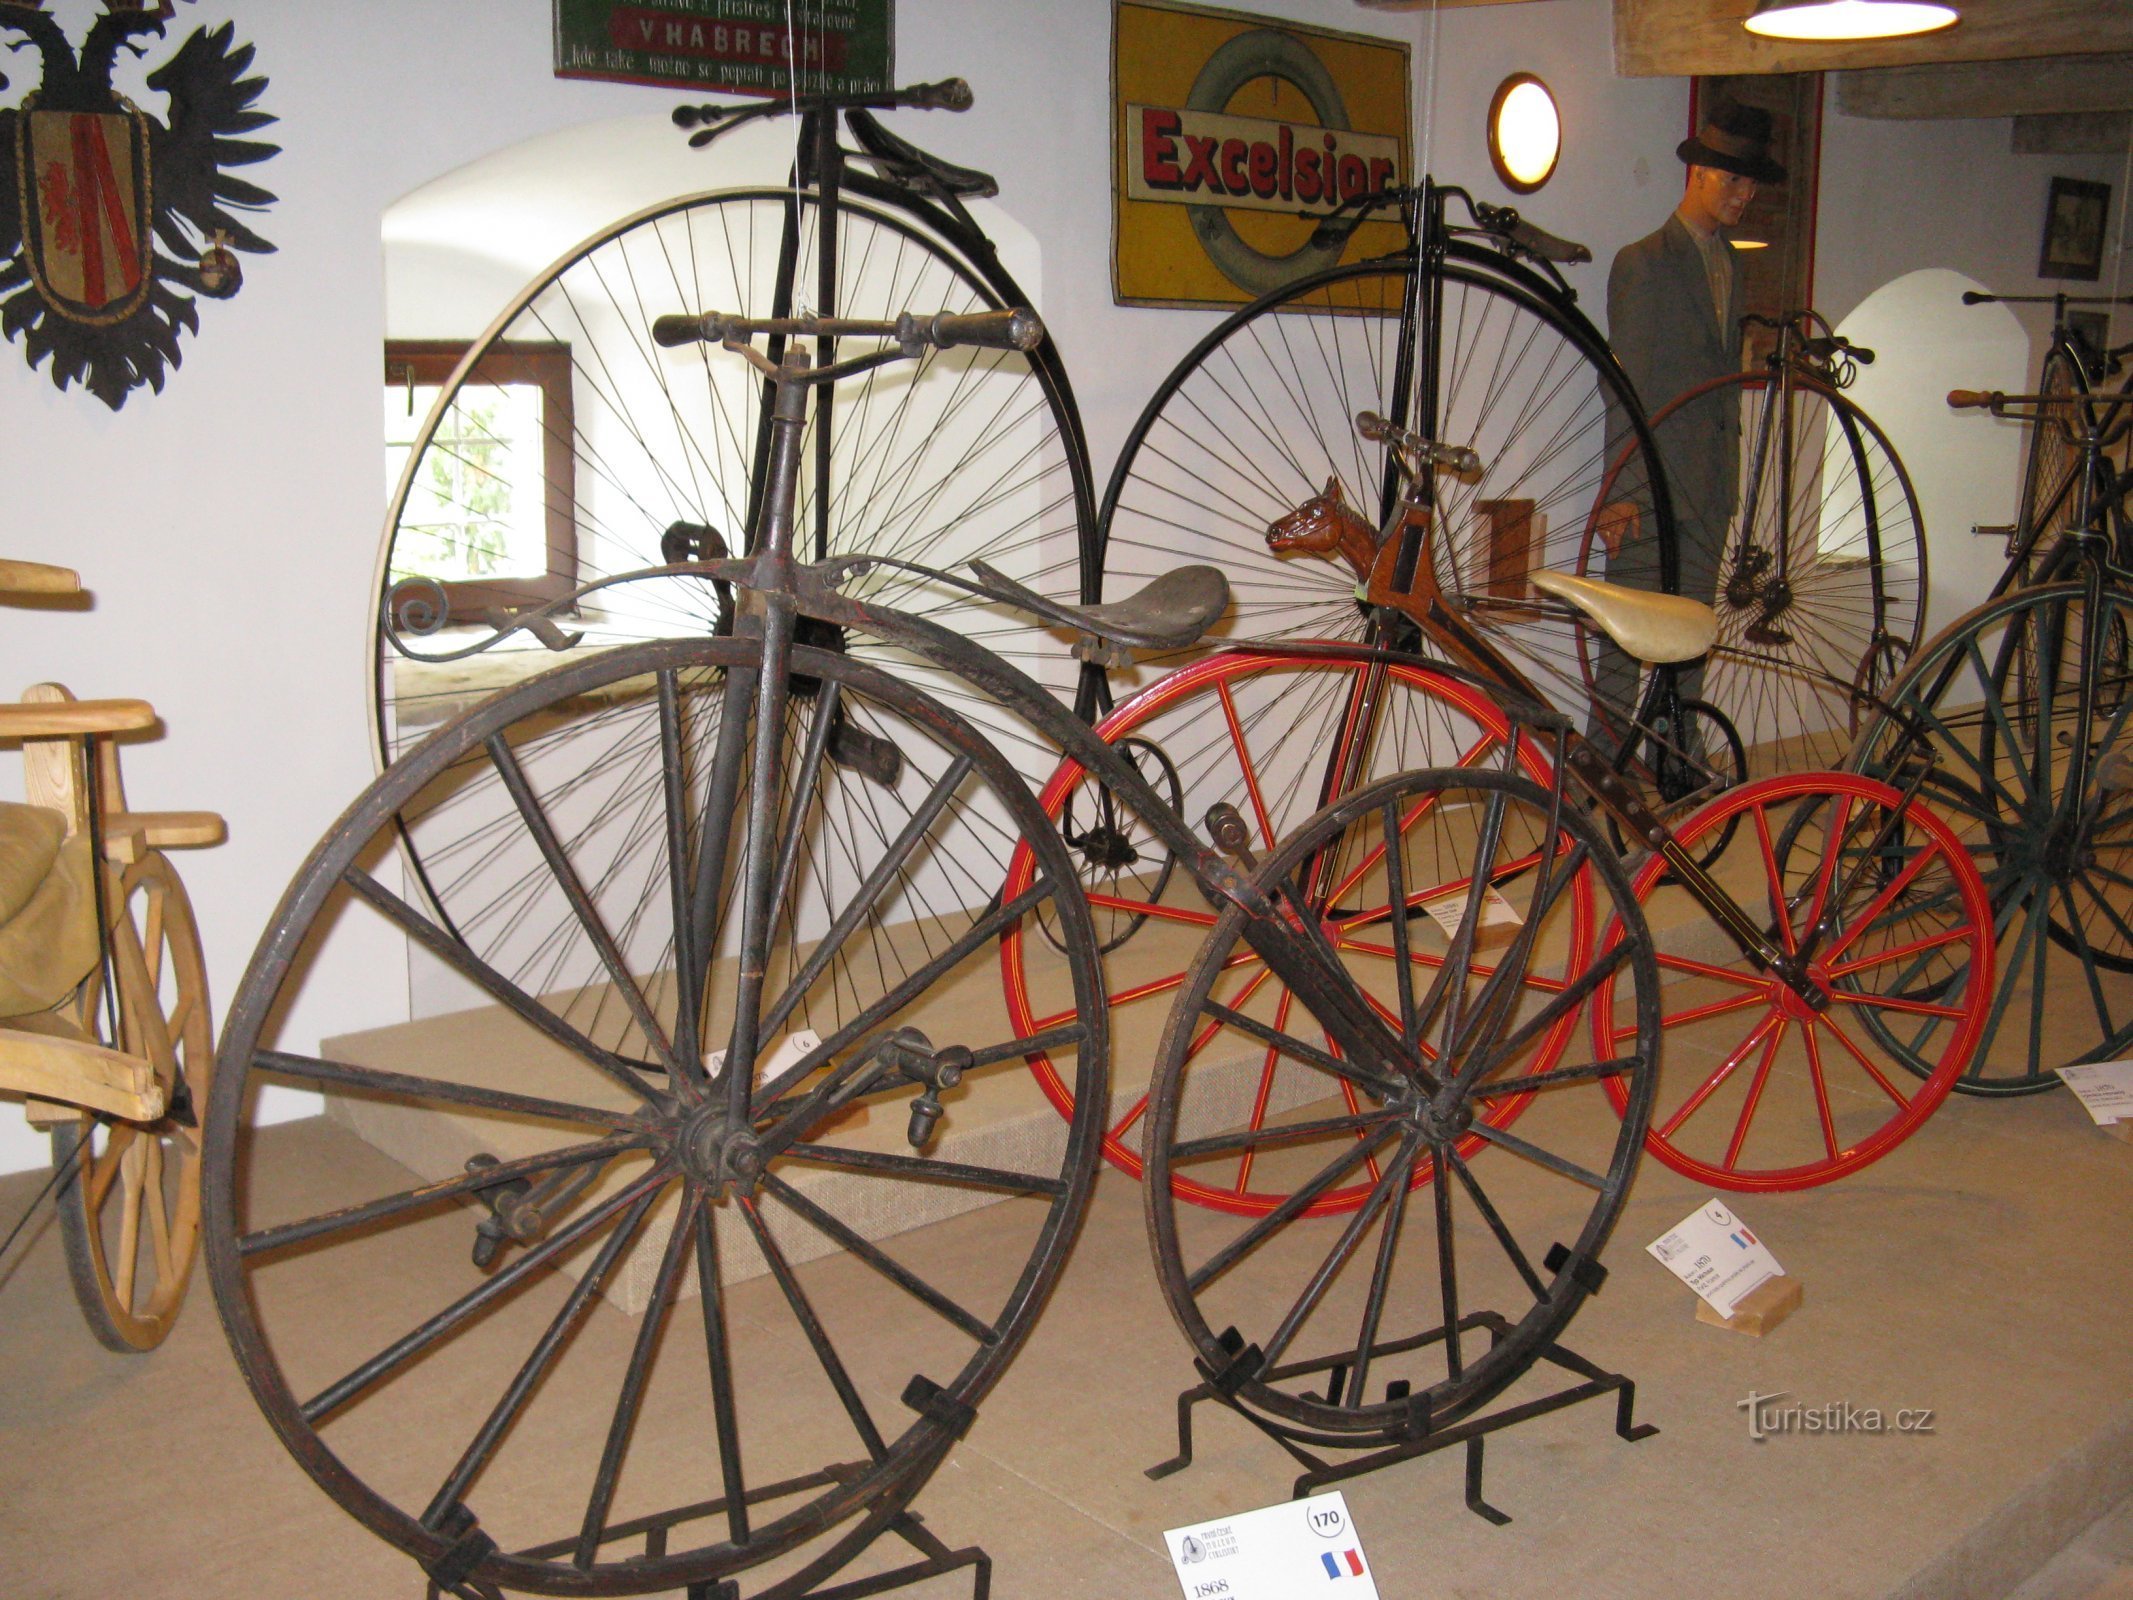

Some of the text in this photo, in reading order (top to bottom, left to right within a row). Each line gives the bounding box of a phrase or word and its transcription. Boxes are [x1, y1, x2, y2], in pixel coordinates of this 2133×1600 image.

[1142, 107, 1395, 208] Excelsior
[1313, 1510, 1340, 1529] 170
[1193, 1578, 1230, 1599] 1868
